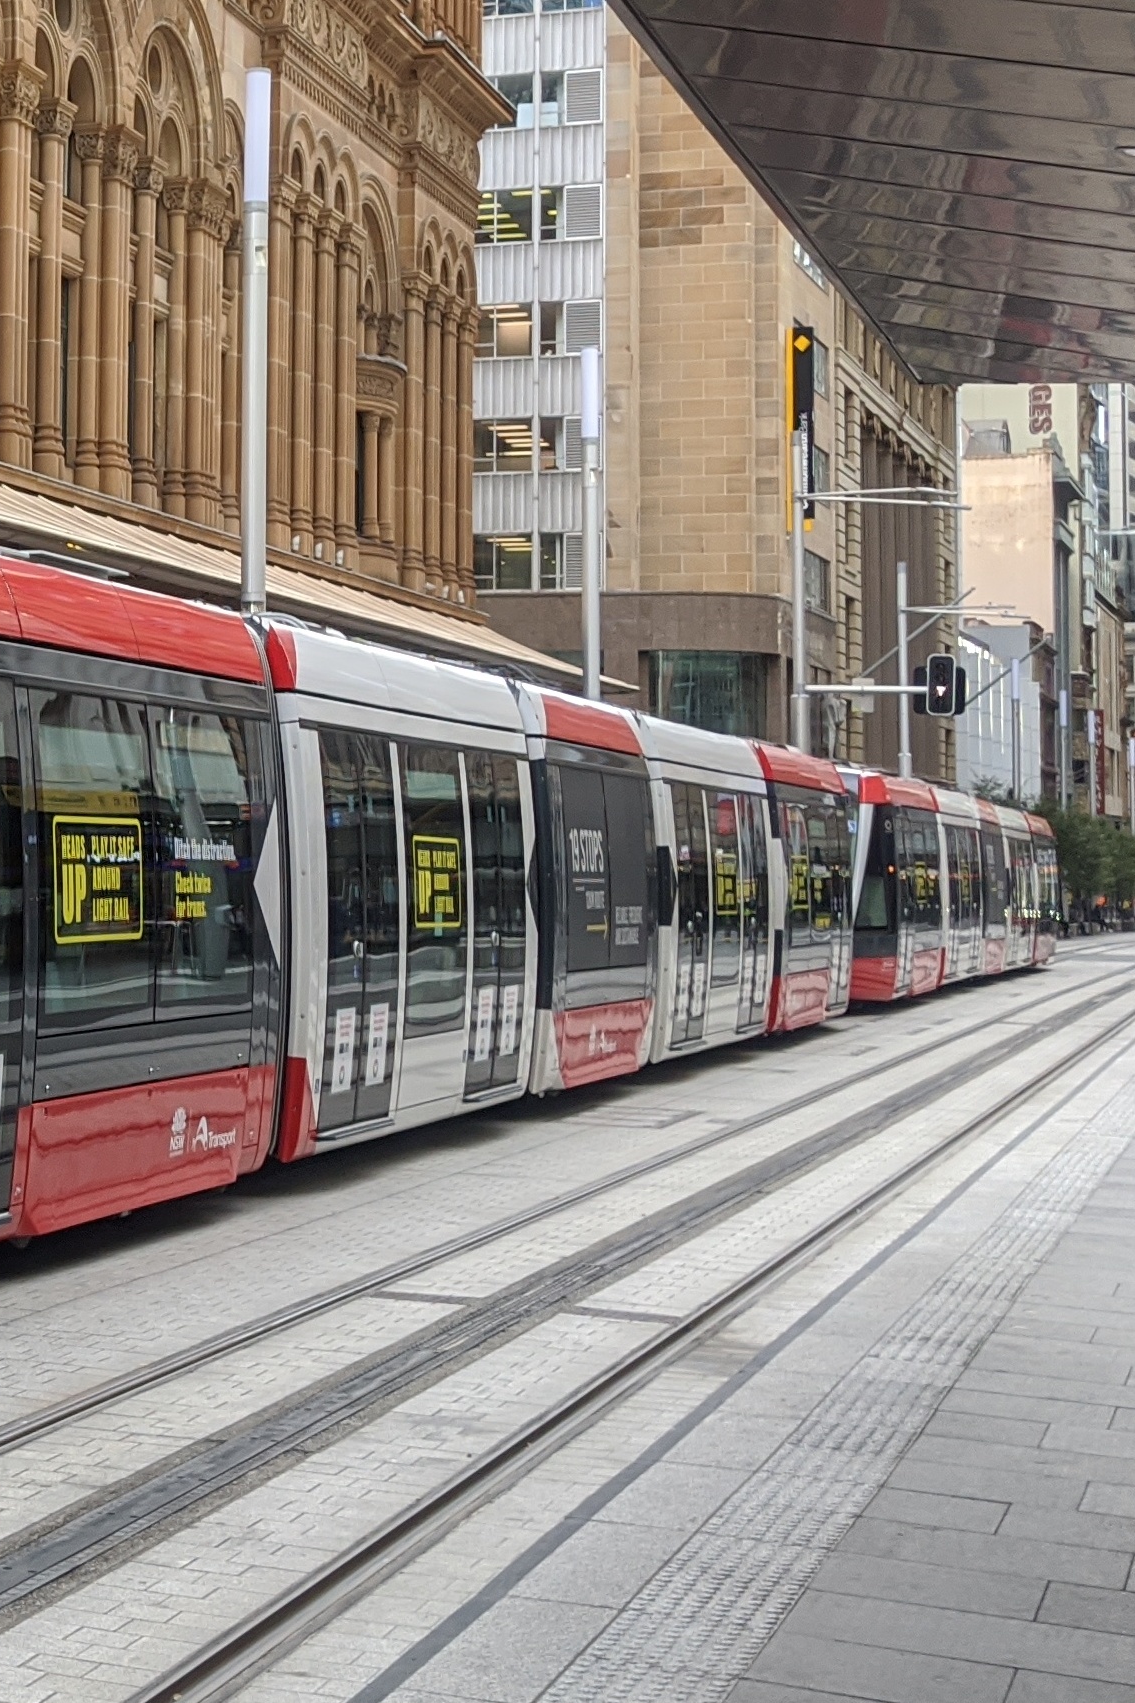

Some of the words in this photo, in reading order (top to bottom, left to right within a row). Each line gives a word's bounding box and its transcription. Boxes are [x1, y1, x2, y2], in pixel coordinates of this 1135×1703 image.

[61, 834, 86, 860] HEADS
[580, 828, 604, 873] STOPS
[61, 863, 87, 924] UP
[208, 1127, 237, 1148] Transport
